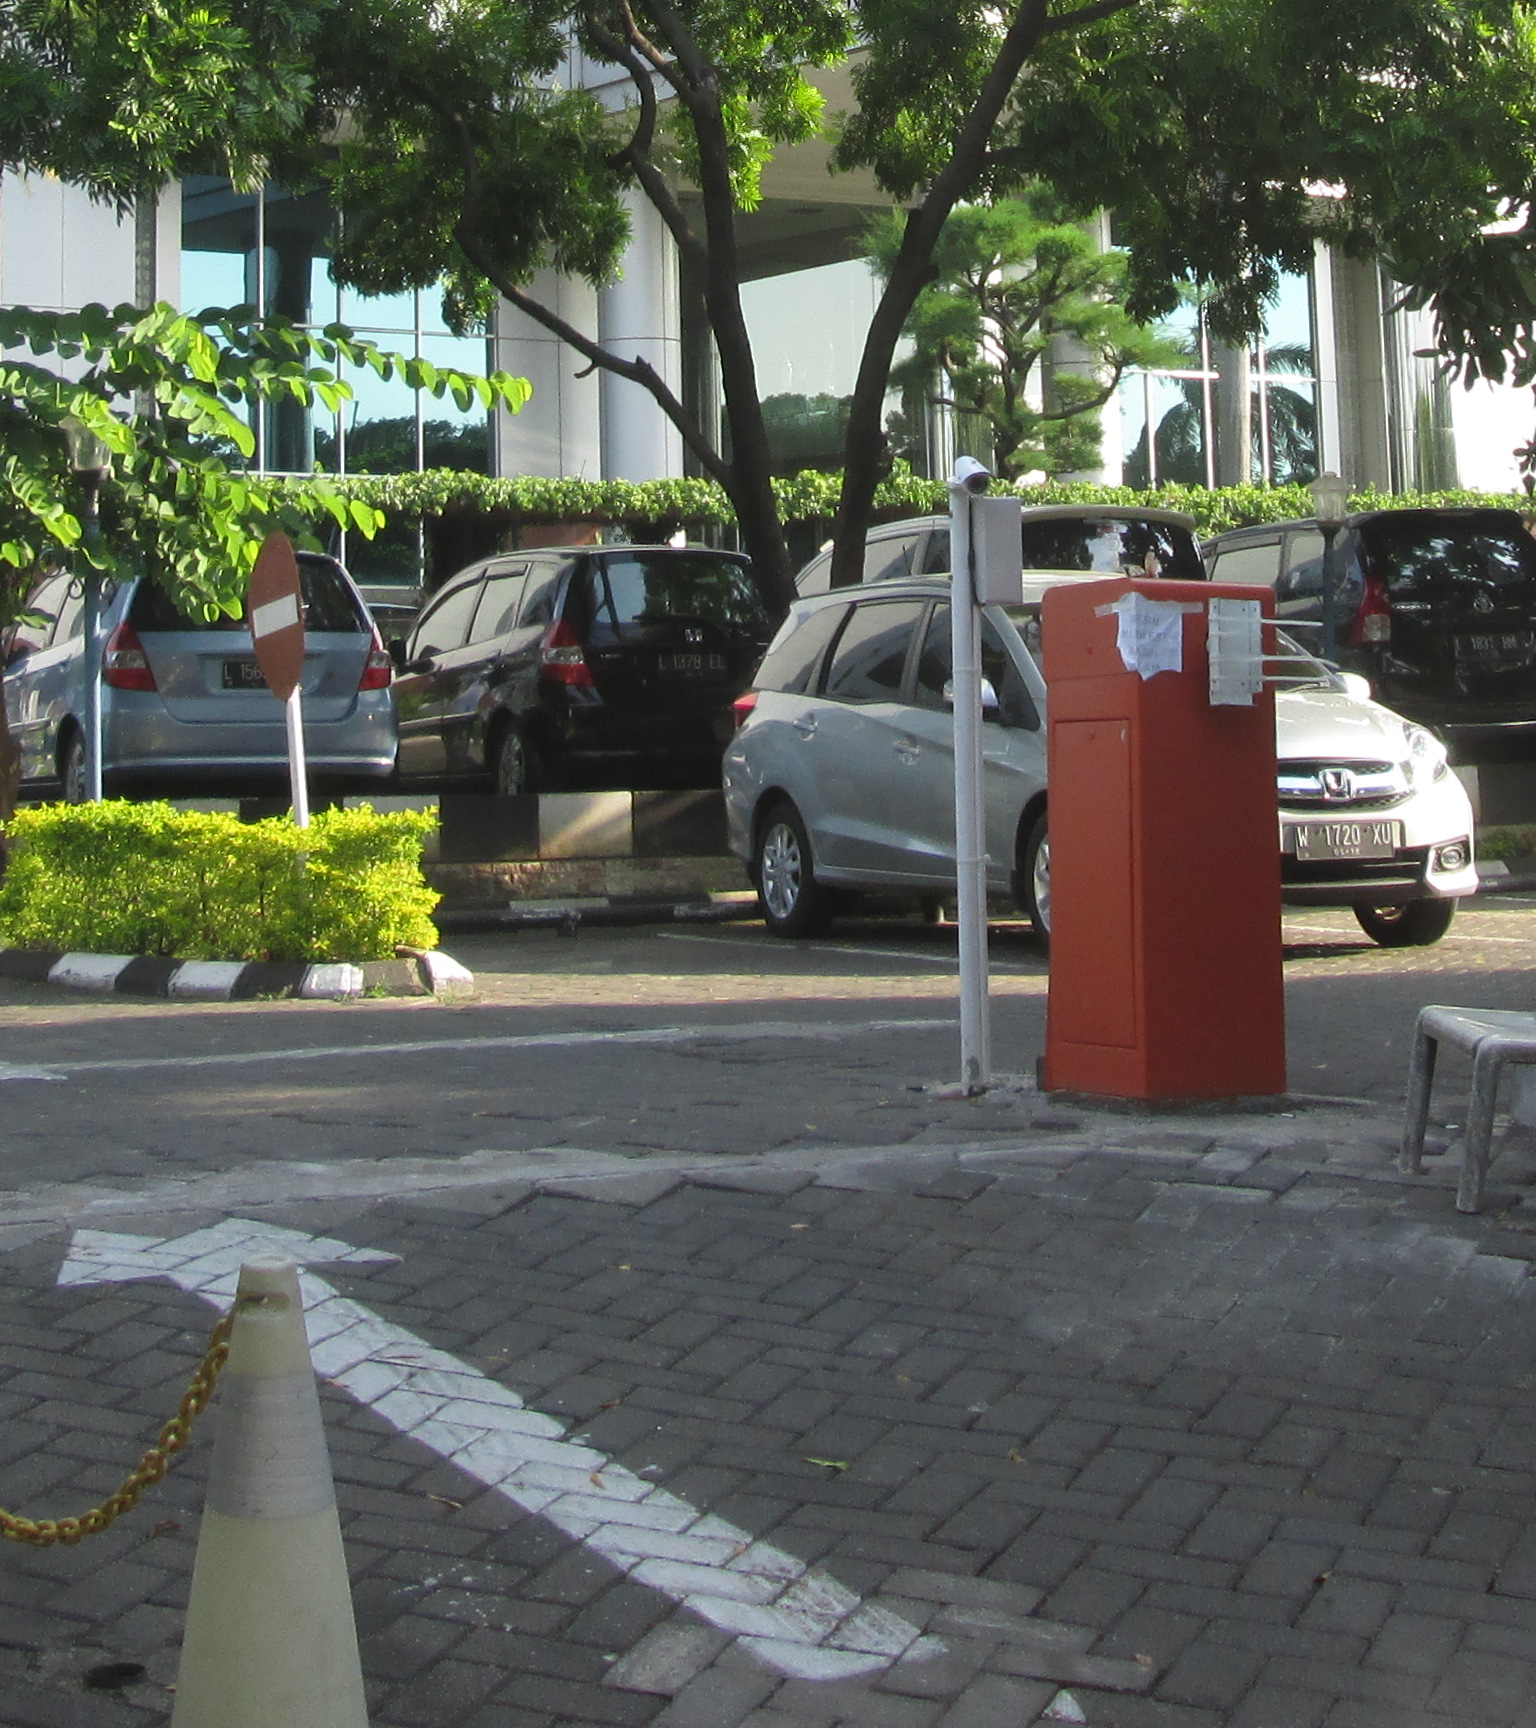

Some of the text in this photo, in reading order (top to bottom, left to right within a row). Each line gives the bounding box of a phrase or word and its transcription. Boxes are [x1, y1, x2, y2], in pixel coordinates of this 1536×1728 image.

[241, 663, 266, 680] 156
[1297, 822, 1392, 848] W 1720 XU
